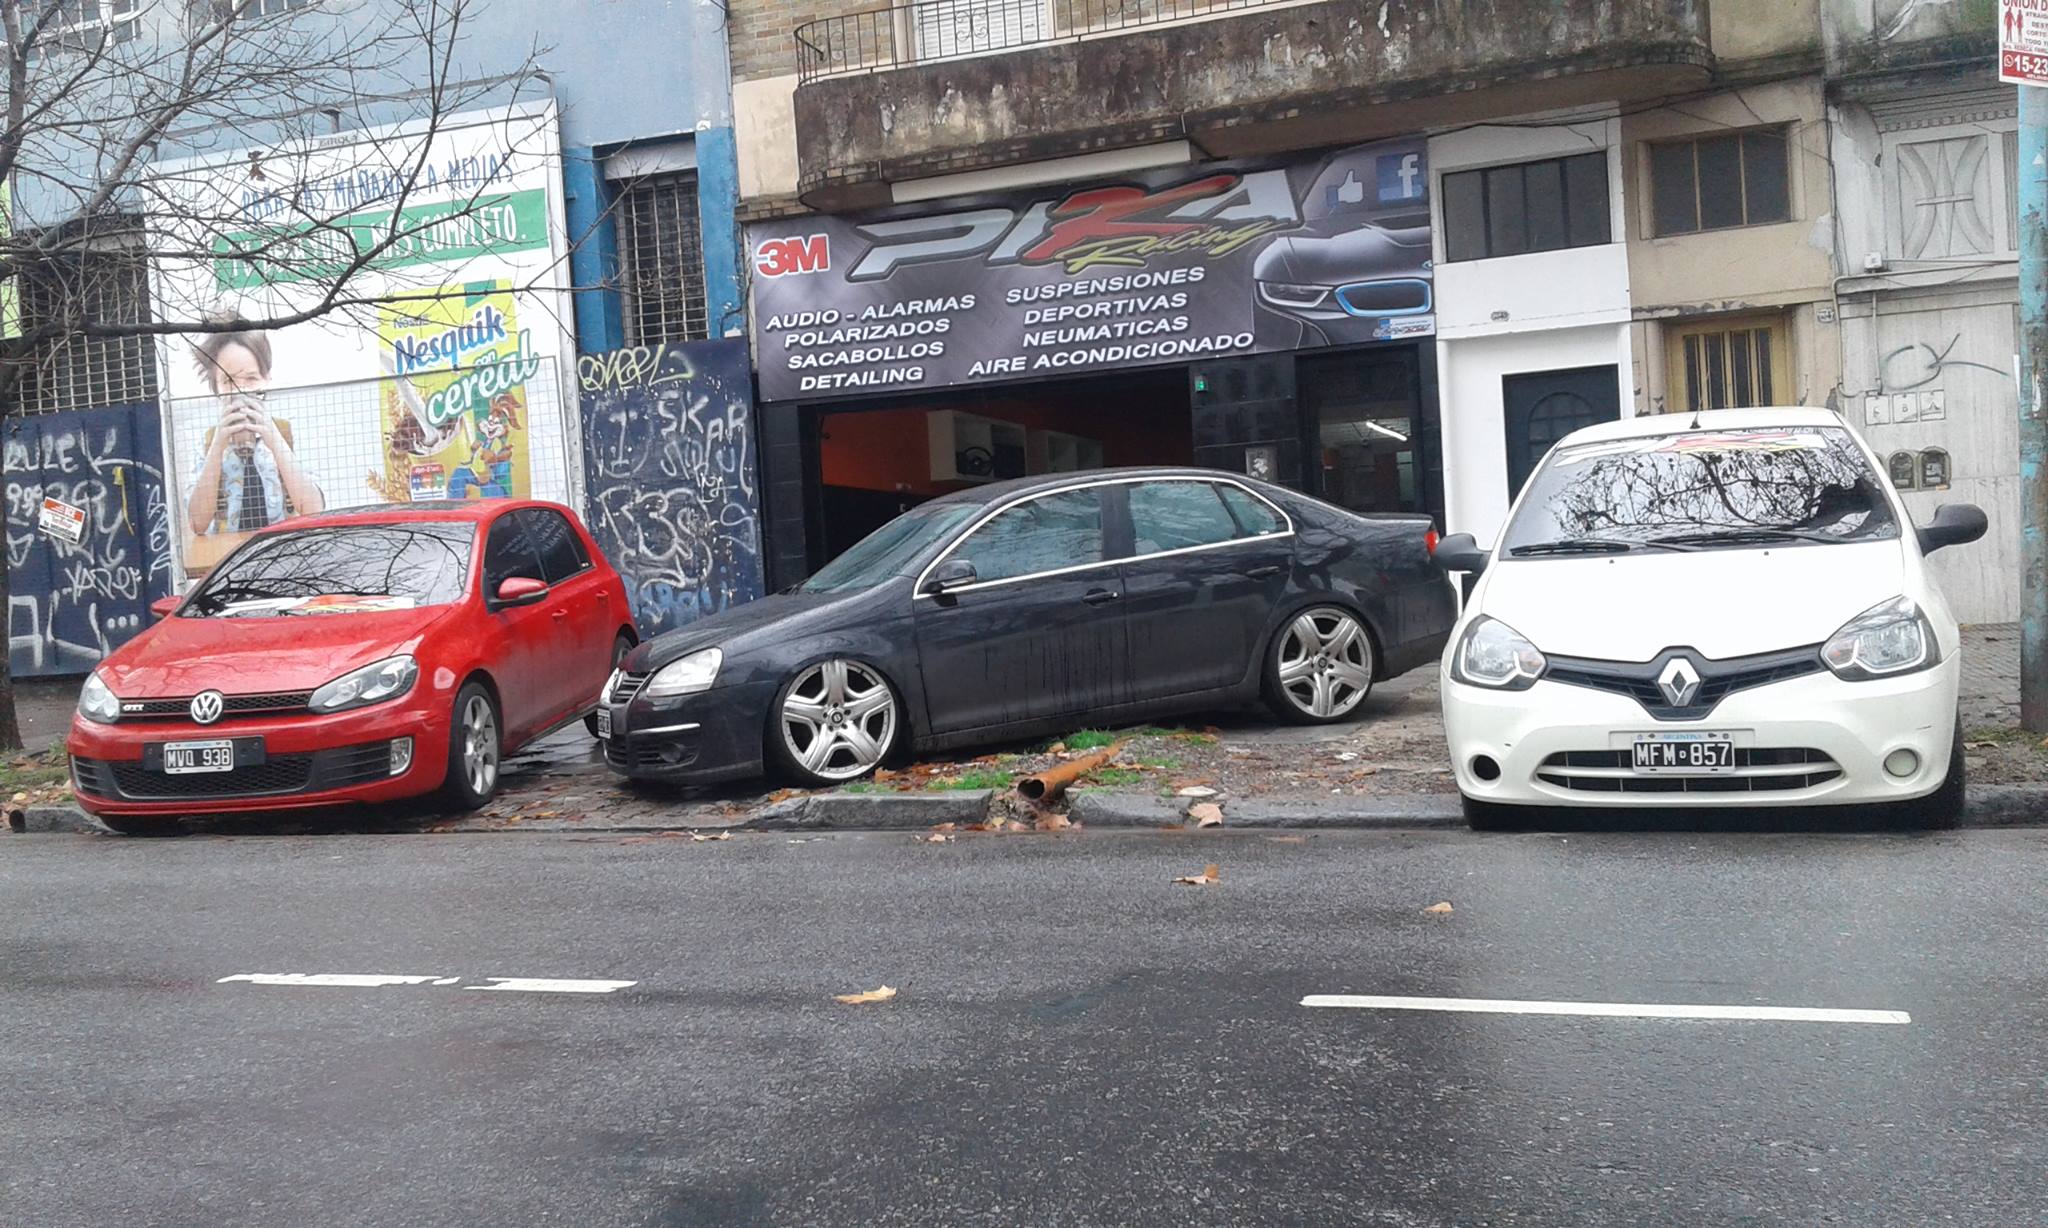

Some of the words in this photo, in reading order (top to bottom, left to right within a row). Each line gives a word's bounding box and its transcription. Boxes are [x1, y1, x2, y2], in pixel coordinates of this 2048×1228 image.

[447, 152, 514, 191] MEDIAS
[757, 233, 831, 279] 3M
[1056, 219, 1290, 275] Racing
[1005, 266, 1206, 304] SUSPENSIONES
[765, 309, 840, 331] AUDIO
[860, 294, 977, 321] ALARMAS
[1023, 292, 1188, 325] DEPORTIVAS
[394, 305, 507, 376] Nesquik
[783, 318, 951, 349] POLARIZADOS
[1022, 315, 1190, 348] NEUMATICAS
[787, 341, 945, 370] SACABOLLOS
[967, 355, 1027, 376] AIRE
[1032, 331, 1255, 370] ACONDICIONADO
[427, 328, 540, 428] cereal
[799, 366, 924, 391] DETAILING
[1636, 743, 1676, 766] MFM
[1690, 743, 1730, 766] 857
